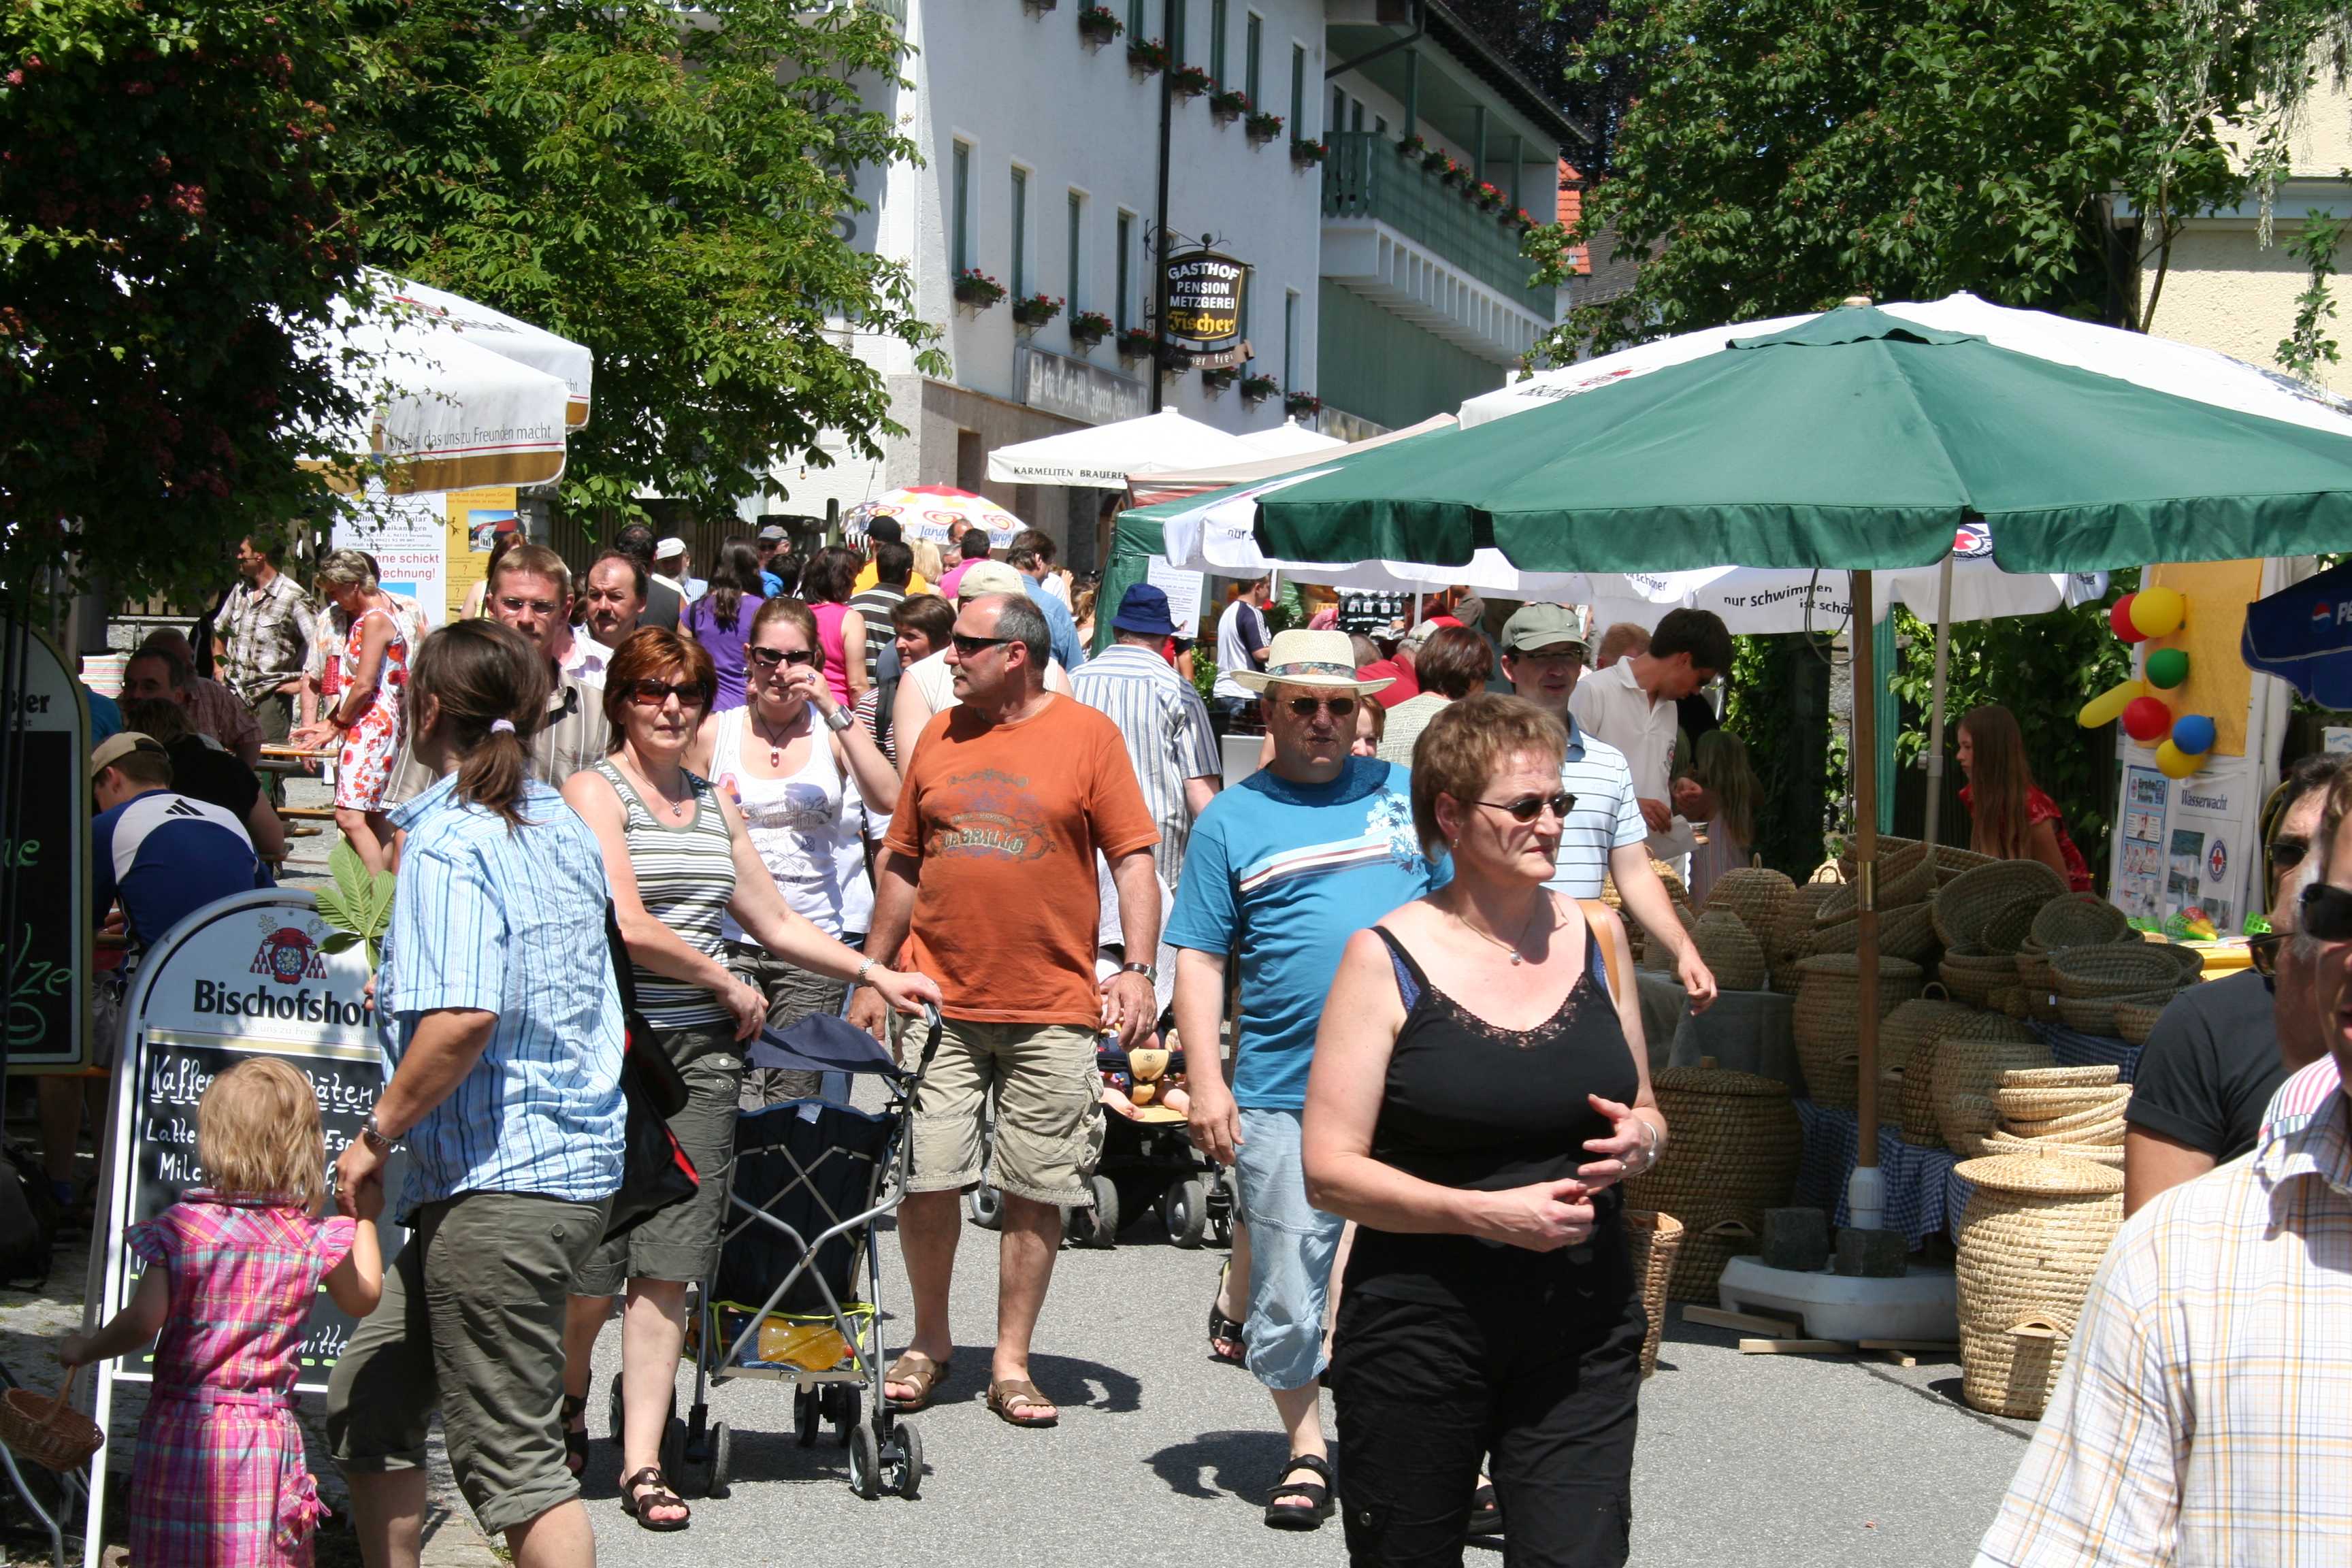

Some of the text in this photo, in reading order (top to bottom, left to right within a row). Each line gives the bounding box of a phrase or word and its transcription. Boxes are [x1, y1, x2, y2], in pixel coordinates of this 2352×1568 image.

[1168, 263, 1240, 280] GASTHOF
[1177, 282, 1229, 294] PENSION
[1170, 296, 1235, 309] METZGEREI
[1168, 311, 1233, 334] Fischer
[424, 429, 442, 447] das
[444, 432, 460, 446] uns
[461, 432, 470, 444] zu
[474, 424, 513, 442] Freunden
[517, 421, 551, 441] macht
[1013, 466, 1074, 477] KARMELITEN
[1228, 529, 1247, 540] nur
[375, 555, 398, 564] nne
[399, 553, 440, 564] schickt
[1724, 596, 1746, 607] nur
[2181, 789, 2227, 811] Wasserwacht
[194, 979, 371, 1027] Bischofshof
[146, 1117, 196, 1143] Latte
